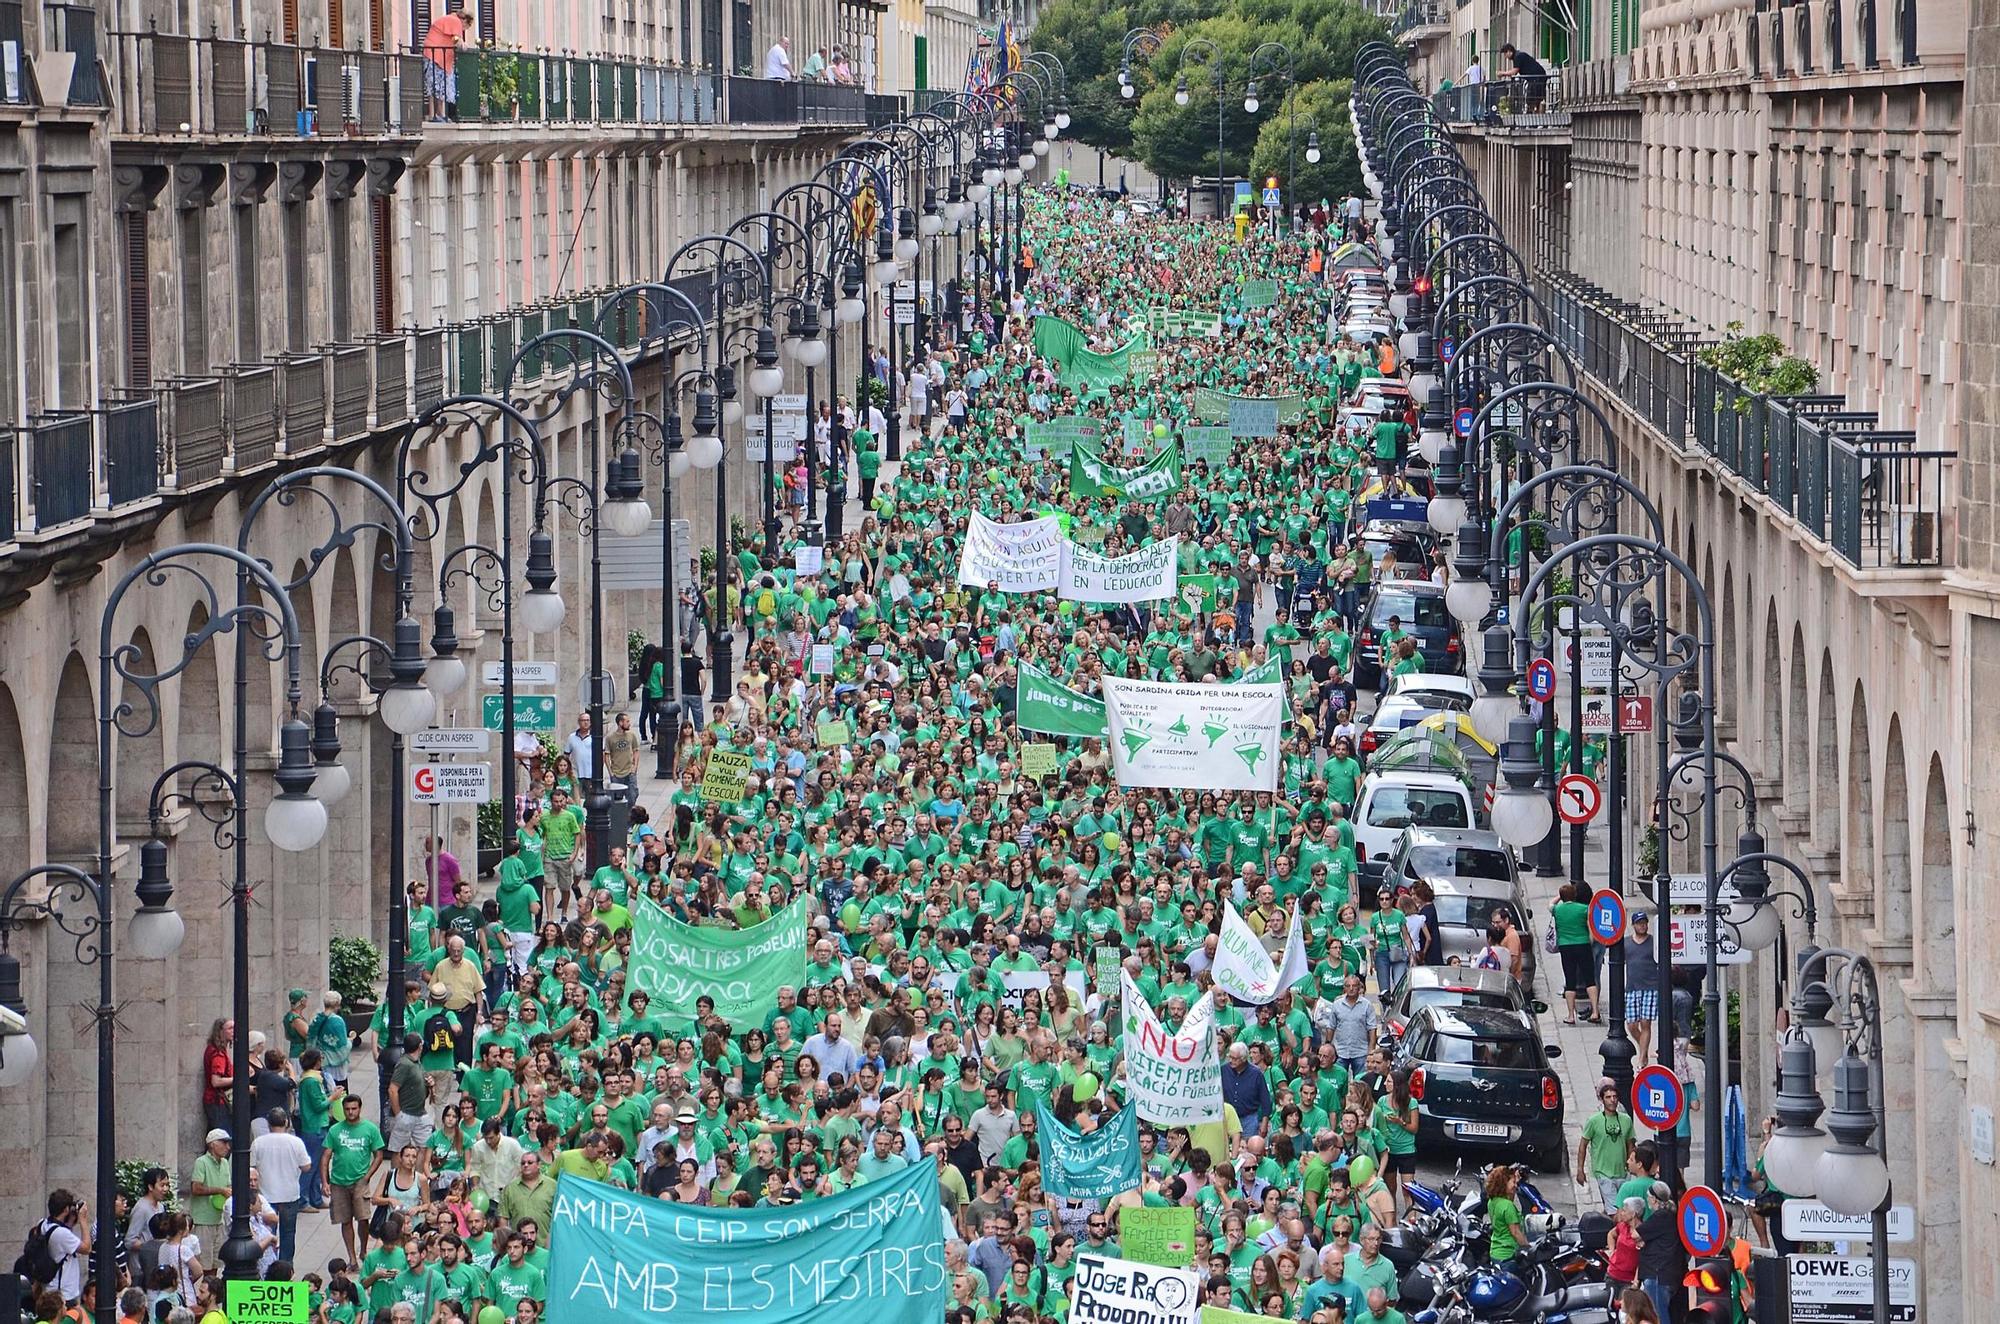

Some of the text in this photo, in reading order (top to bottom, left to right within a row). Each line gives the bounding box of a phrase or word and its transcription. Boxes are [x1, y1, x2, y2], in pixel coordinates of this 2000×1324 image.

[746, 438, 793, 450] bultaup
[1071, 557, 1088, 571] PER
[1092, 562, 1106, 574] LA
[1073, 575, 1089, 588] EN
[521, 666, 542, 675] ASPRER
[1114, 684, 1133, 693] SON
[1135, 685, 1173, 695] SARDINA
[1175, 688, 1201, 697] CRIDA
[1204, 689, 1219, 697] PER
[1221, 690, 1239, 698] UNA
[1026, 687, 1100, 714] junts per
[451, 733, 474, 743] ASPRER
[440, 767, 468, 777] DISPONIBLE
[468, 767, 478, 777] PER
[438, 778, 485, 787] LA SEVA PUBLICITAT
[447, 788, 476, 797] 971 00 45 22
[702, 786, 740, 801] L'ESCOLA
[1680, 881, 1690, 891] LA
[1603, 912, 1610, 923] P
[632, 929, 742, 971] VOSALTRES
[1221, 927, 1269, 981] ALUMNES
[1141, 1020, 1197, 1063] NO
[1185, 1066, 1206, 1084] PER
[1653, 1092, 1661, 1104] P
[1645, 1109, 1670, 1119] MOTOS
[1463, 1124, 1505, 1135] 3199 HRJ
[1095, 1186, 1113, 1196] SON
[553, 1186, 925, 1244] AMIPA CEIP SON SERRA
[1890, 1211, 1899, 1225] III
[1698, 1216, 1706, 1230] P
[1143, 1241, 1165, 1253] PER
[569, 1241, 947, 1314] AMB ELS MESTRES
[1076, 1257, 1127, 1296] JOSE
[1827, 1280, 1873, 1288] entertainmen
[249, 1285, 294, 1303] SOM
[1791, 1289, 1815, 1297] OEWE.
[238, 1302, 293, 1317] PARES
